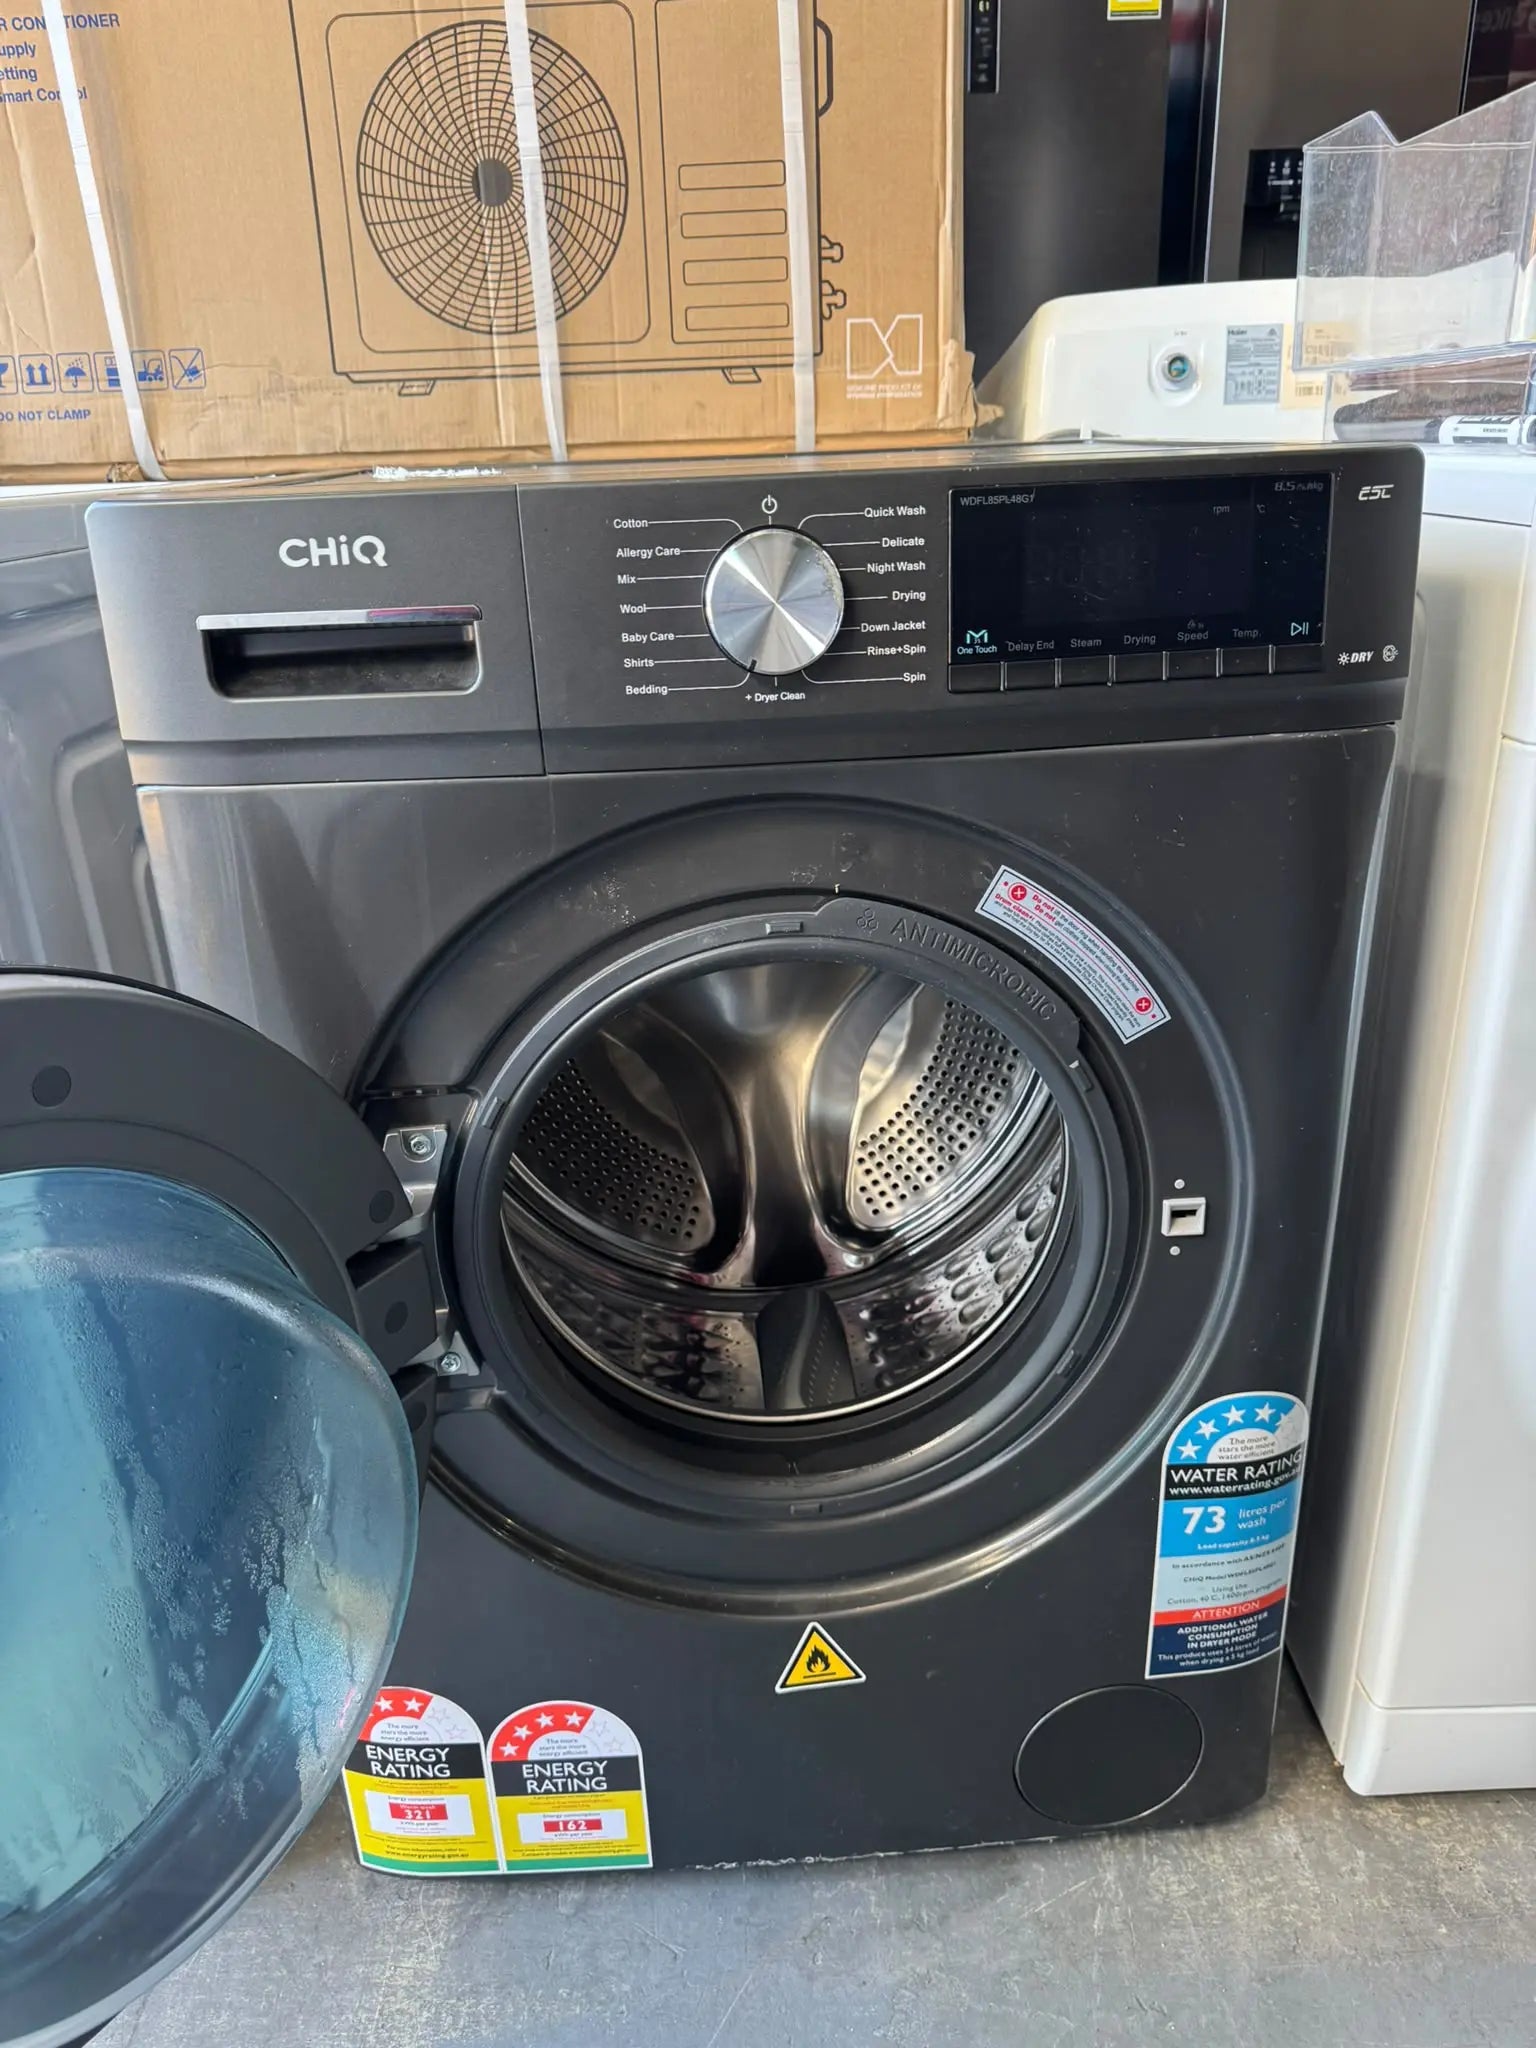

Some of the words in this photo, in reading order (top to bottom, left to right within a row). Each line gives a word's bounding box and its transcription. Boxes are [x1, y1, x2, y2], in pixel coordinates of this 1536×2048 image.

[12, 14, 120, 31] CONTIONER
[18, 410, 42, 421] NOT
[47, 409, 91, 420] CLAMP
[864, 507, 895, 517] Quick
[896, 506, 926, 516] Wash
[1212, 505, 1230, 515] rpm
[613, 519, 648, 529] Cotton
[882, 537, 925, 547] Delicate
[279, 534, 388, 568] CHiQ
[616, 548, 653, 559] Allergy
[655, 546, 681, 556] Care
[867, 564, 895, 574] Night
[898, 561, 926, 571] Wash
[617, 574, 636, 584] Mix
[892, 591, 926, 602] Drying
[619, 604, 647, 613] Wool
[861, 623, 890, 632] Down
[892, 621, 926, 631] Jacket
[621, 633, 647, 643] Baby
[650, 631, 675, 641] Care
[1070, 638, 1102, 648] Steam
[1124, 634, 1156, 645] Drying
[1176, 631, 1209, 643] Speed
[867, 645, 926, 656] Rinse+Spin
[957, 646, 973, 655] One
[975, 644, 997, 654] Touch
[1008, 642, 1035, 652] Delay
[1037, 640, 1055, 650] End
[624, 658, 654, 667] Shirts
[1349, 651, 1373, 664] DRY
[903, 673, 926, 683] Spin
[626, 685, 668, 695] Bedding
[755, 692, 778, 703] Dryer
[780, 692, 805, 701] Clean
[994, 892, 1012, 906] Drum
[1032, 893, 1043, 903] Do
[1042, 900, 1054, 911] not
[1034, 903, 1044, 913] Do
[1044, 910, 1056, 921] not
[890, 917, 1057, 1022] ANTIMICROBIC
[1230, 1437, 1246, 1445] The
[1170, 1468, 1239, 1484] WATER
[1244, 1449, 1303, 1480] RATING
[1182, 1505, 1227, 1535] 73
[1239, 1508, 1267, 1519] litres
[1237, 1517, 1267, 1530] wash
[1192, 1600, 1260, 1619] ATTENTION
[1177, 1622, 1238, 1635] ADDITIONAL
[1239, 1611, 1268, 1626] WATER
[1188, 1623, 1258, 1641] CONSUMPTION
[1187, 1641, 1199, 1649] IN
[1199, 1636, 1230, 1648] DRYER
[1231, 1631, 1257, 1643] MODE
[1157, 1653, 1174, 1661] This
[1200, 1656, 1224, 1665] drying
[365, 1744, 450, 1763] ENERGY
[370, 1761, 451, 1778] RATING
[522, 1759, 608, 1779] ENERGY
[526, 1776, 607, 1794] RATING
[404, 1809, 432, 1820] 321
[559, 1820, 588, 1831] 162
